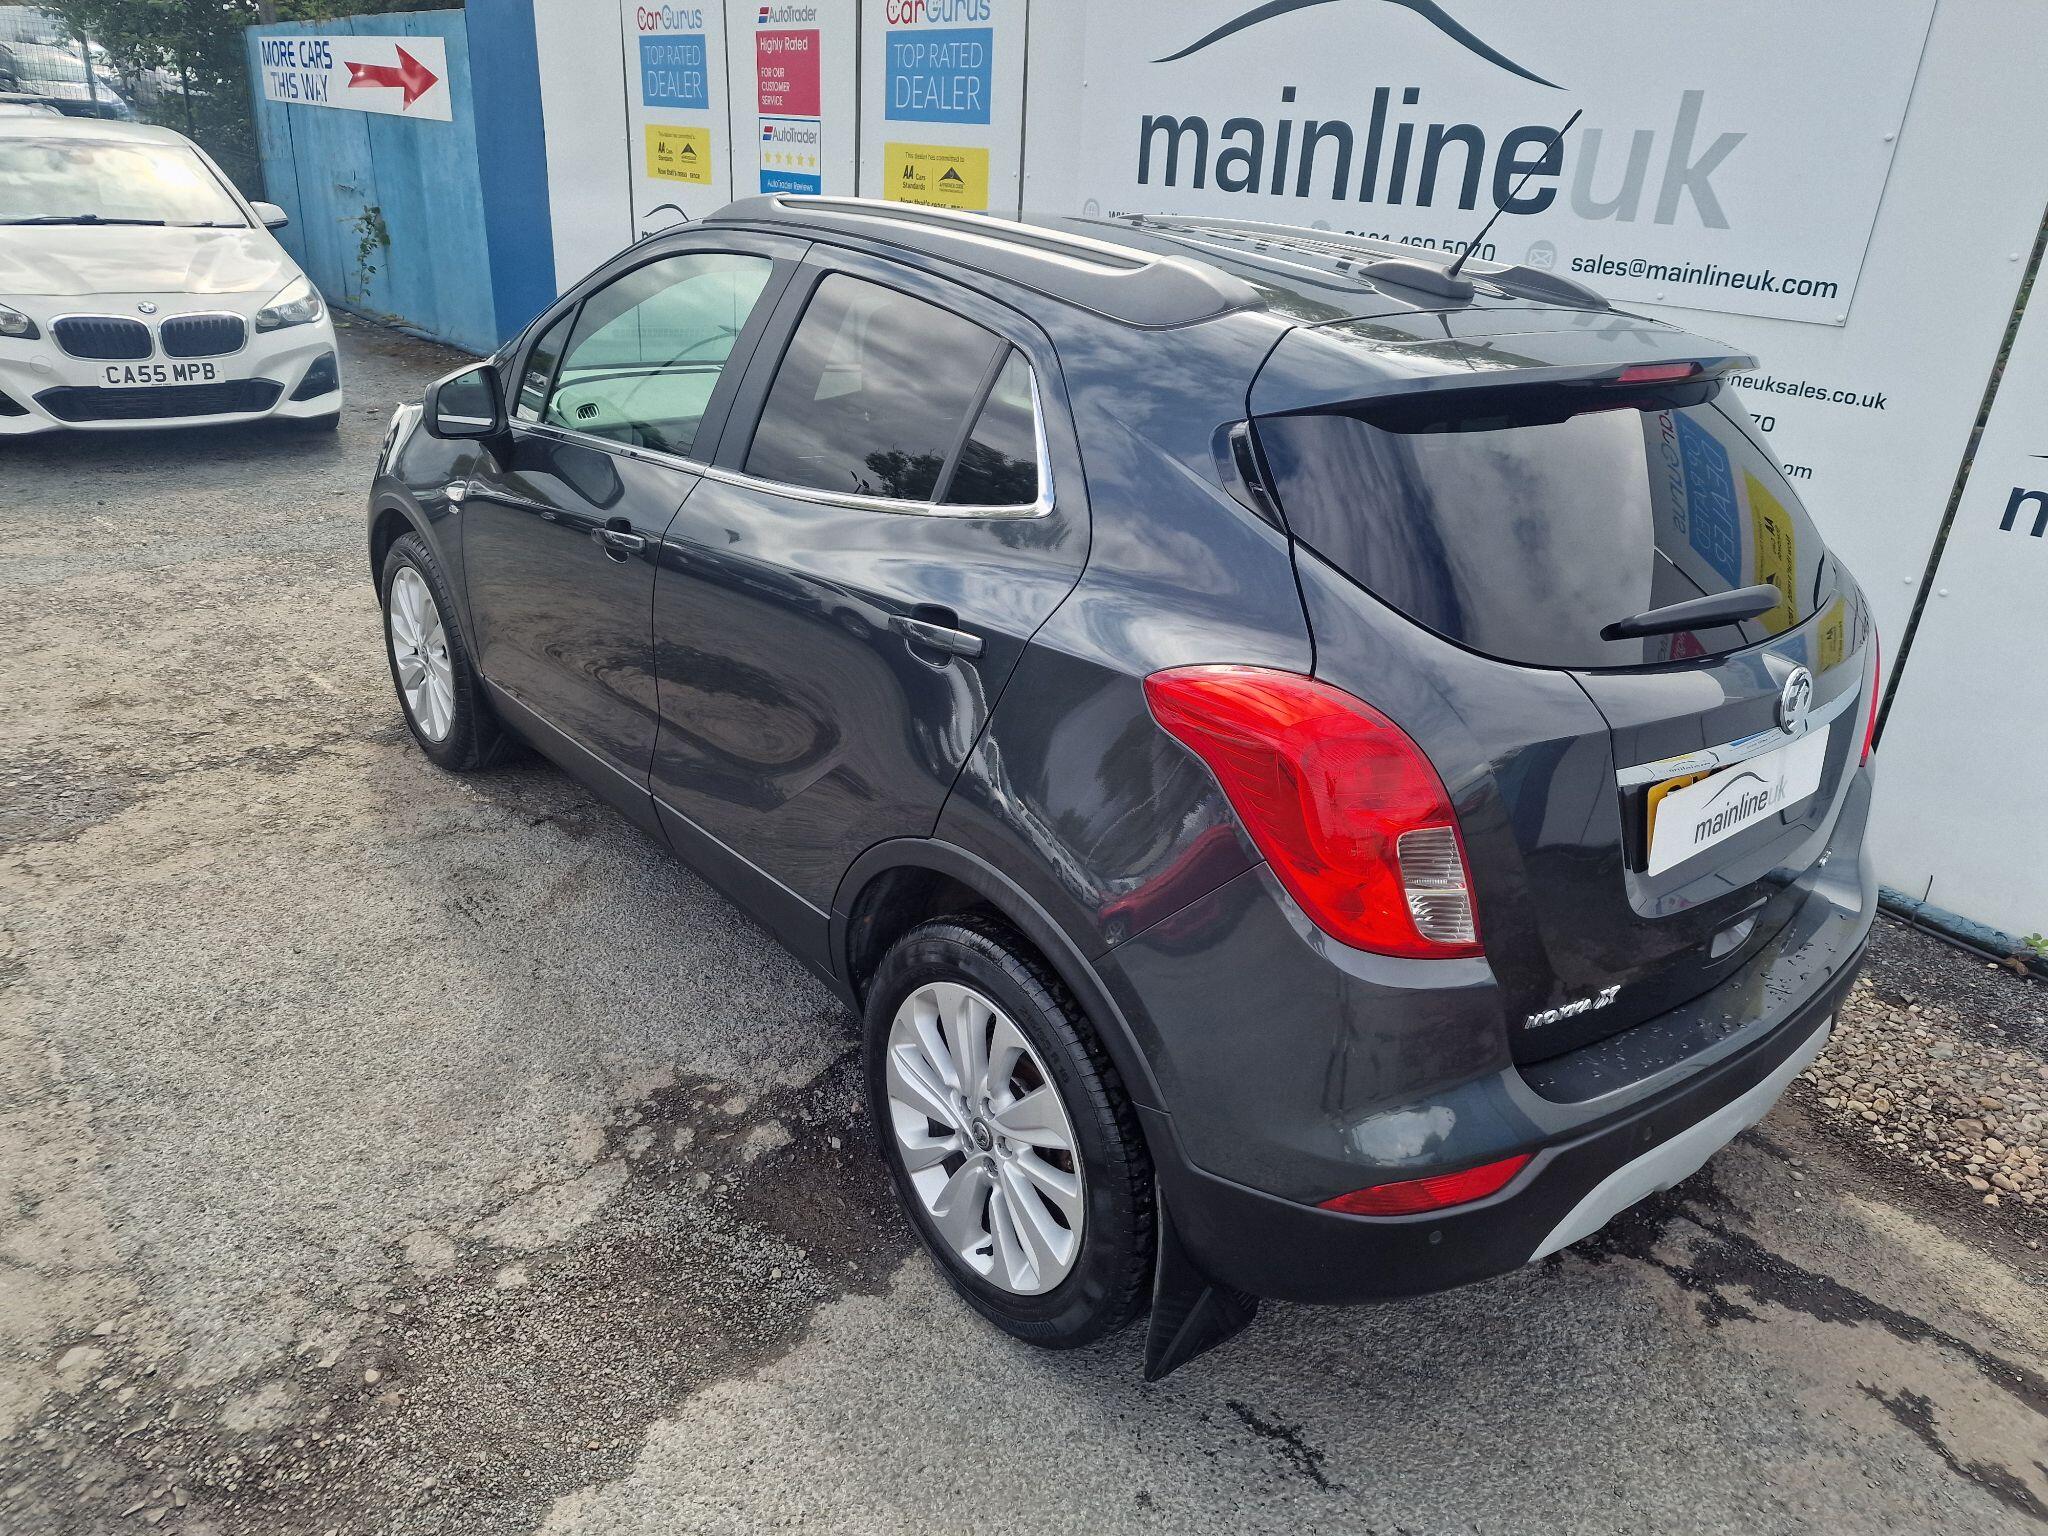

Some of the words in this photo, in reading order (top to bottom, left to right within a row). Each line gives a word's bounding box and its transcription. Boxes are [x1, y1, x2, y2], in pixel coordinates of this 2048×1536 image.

[637, 4, 703, 30] CarGurus
[769, 5, 817, 23] AutoTrader
[886, 0, 991, 24] CarGurus
[261, 40, 296, 68] MORE
[299, 40, 332, 69] CARS
[644, 45, 665, 65] TOP
[667, 45, 701, 66] RATED
[760, 36, 783, 54] Highly
[785, 36, 808, 51] Rated
[893, 43, 926, 68] TOP
[929, 42, 983, 69] RATED
[647, 70, 703, 98] DEALER
[761, 67, 772, 77] FOR
[773, 67, 785, 78] OUR
[270, 71, 298, 98] THIS
[301, 73, 328, 102] WAY
[761, 81, 790, 91] CUSTOMER
[895, 75, 981, 110] DEALER
[761, 95, 783, 106] SERVICE
[772, 126, 818, 144] AutoTrader
[1137, 86, 1749, 230] mainlineuk
[902, 164, 914, 180] AA
[793, 181, 814, 192] Reviews
[902, 181, 926, 191] Standards
[1570, 253, 1839, 299] sales@mainlineuk.com
[105, 365, 168, 384] CA55
[172, 362, 216, 381] MPB
[1727, 375, 1888, 410] neuksales.co.uk
[1693, 773, 1789, 845] mainlineuk
